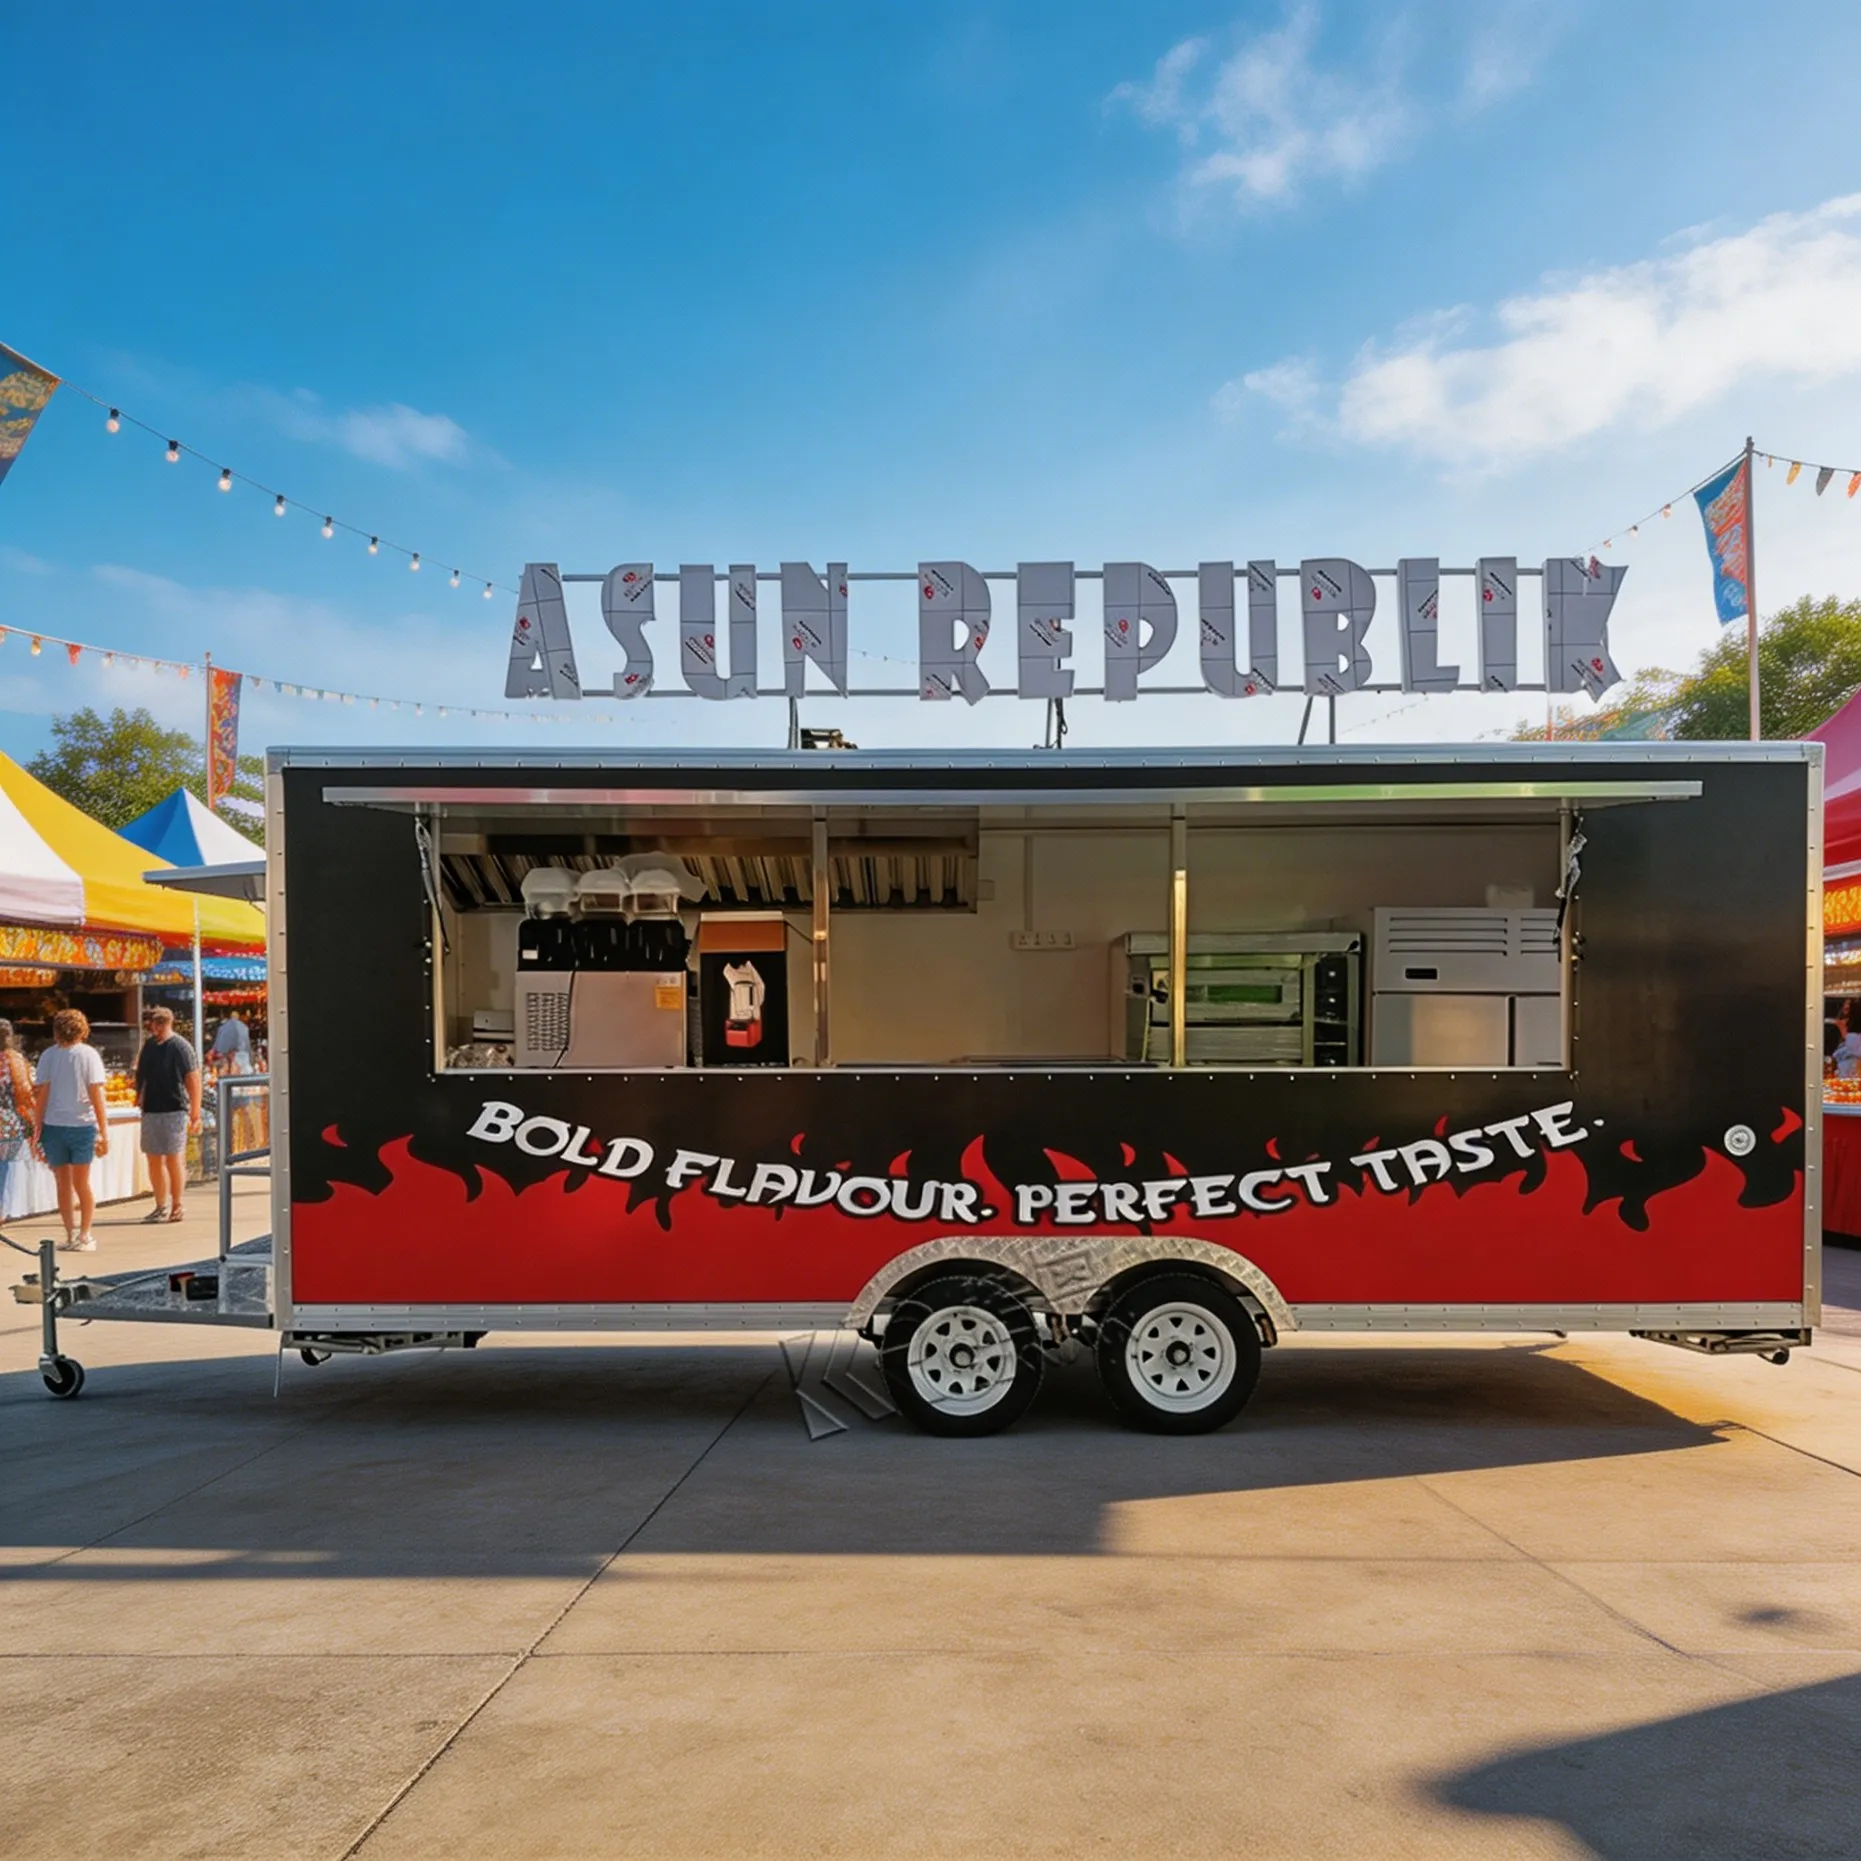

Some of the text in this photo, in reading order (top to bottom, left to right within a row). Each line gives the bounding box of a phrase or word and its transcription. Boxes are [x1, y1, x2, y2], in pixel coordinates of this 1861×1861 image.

[504, 556, 1630, 707] ASUN REPUBLIK
[466, 1101, 654, 1178] BOLD
[665, 1148, 993, 1224] FLAVOUR.
[1015, 1161, 1332, 1223] PERFECT
